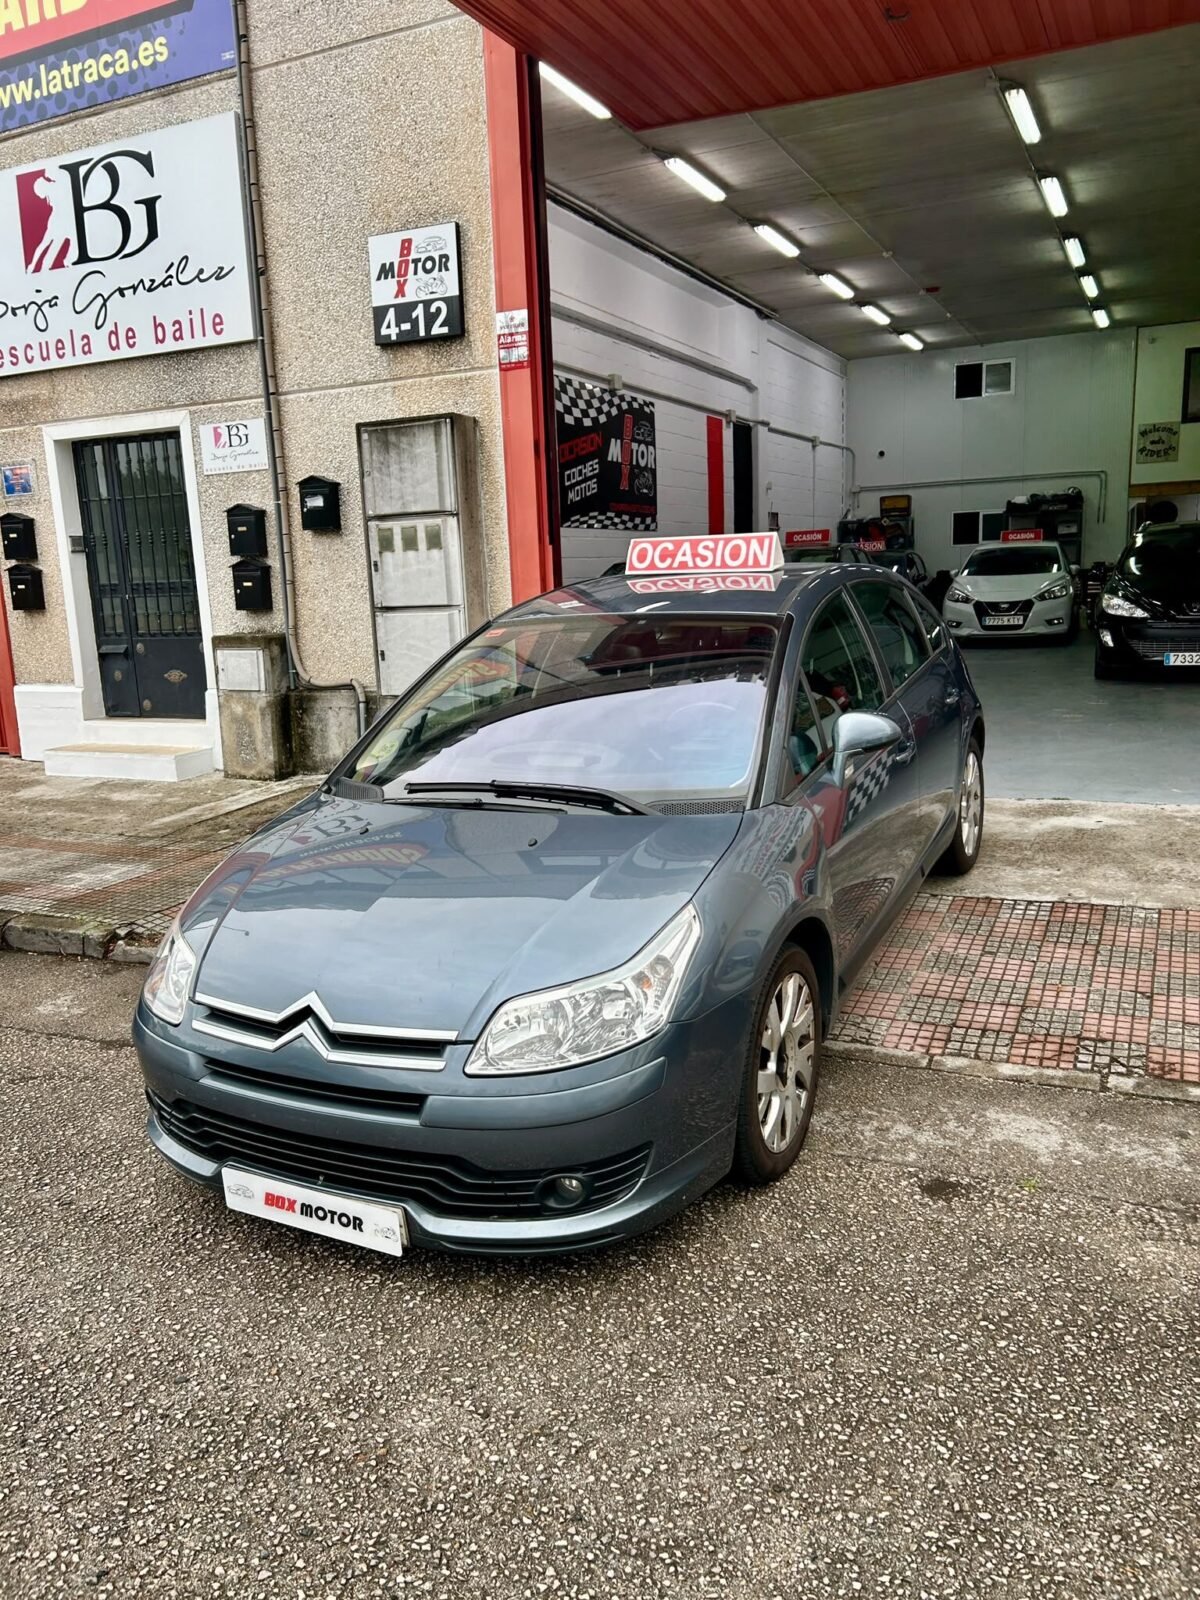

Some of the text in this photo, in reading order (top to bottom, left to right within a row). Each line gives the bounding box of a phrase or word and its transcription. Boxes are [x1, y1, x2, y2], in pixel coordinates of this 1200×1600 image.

[59, 150, 162, 266] BG
[108, 322, 137, 351] de
[153, 308, 225, 345] baile
[380, 300, 449, 341] 4-12
[499, 334, 527, 344] Alarma
[564, 458, 600, 487] COCHES
[567, 478, 598, 505] MOTOS
[631, 537, 770, 570] OCASION
[1172, 654, 1200, 664] 7332
[264, 1192, 364, 1233] BOX MOTOR
